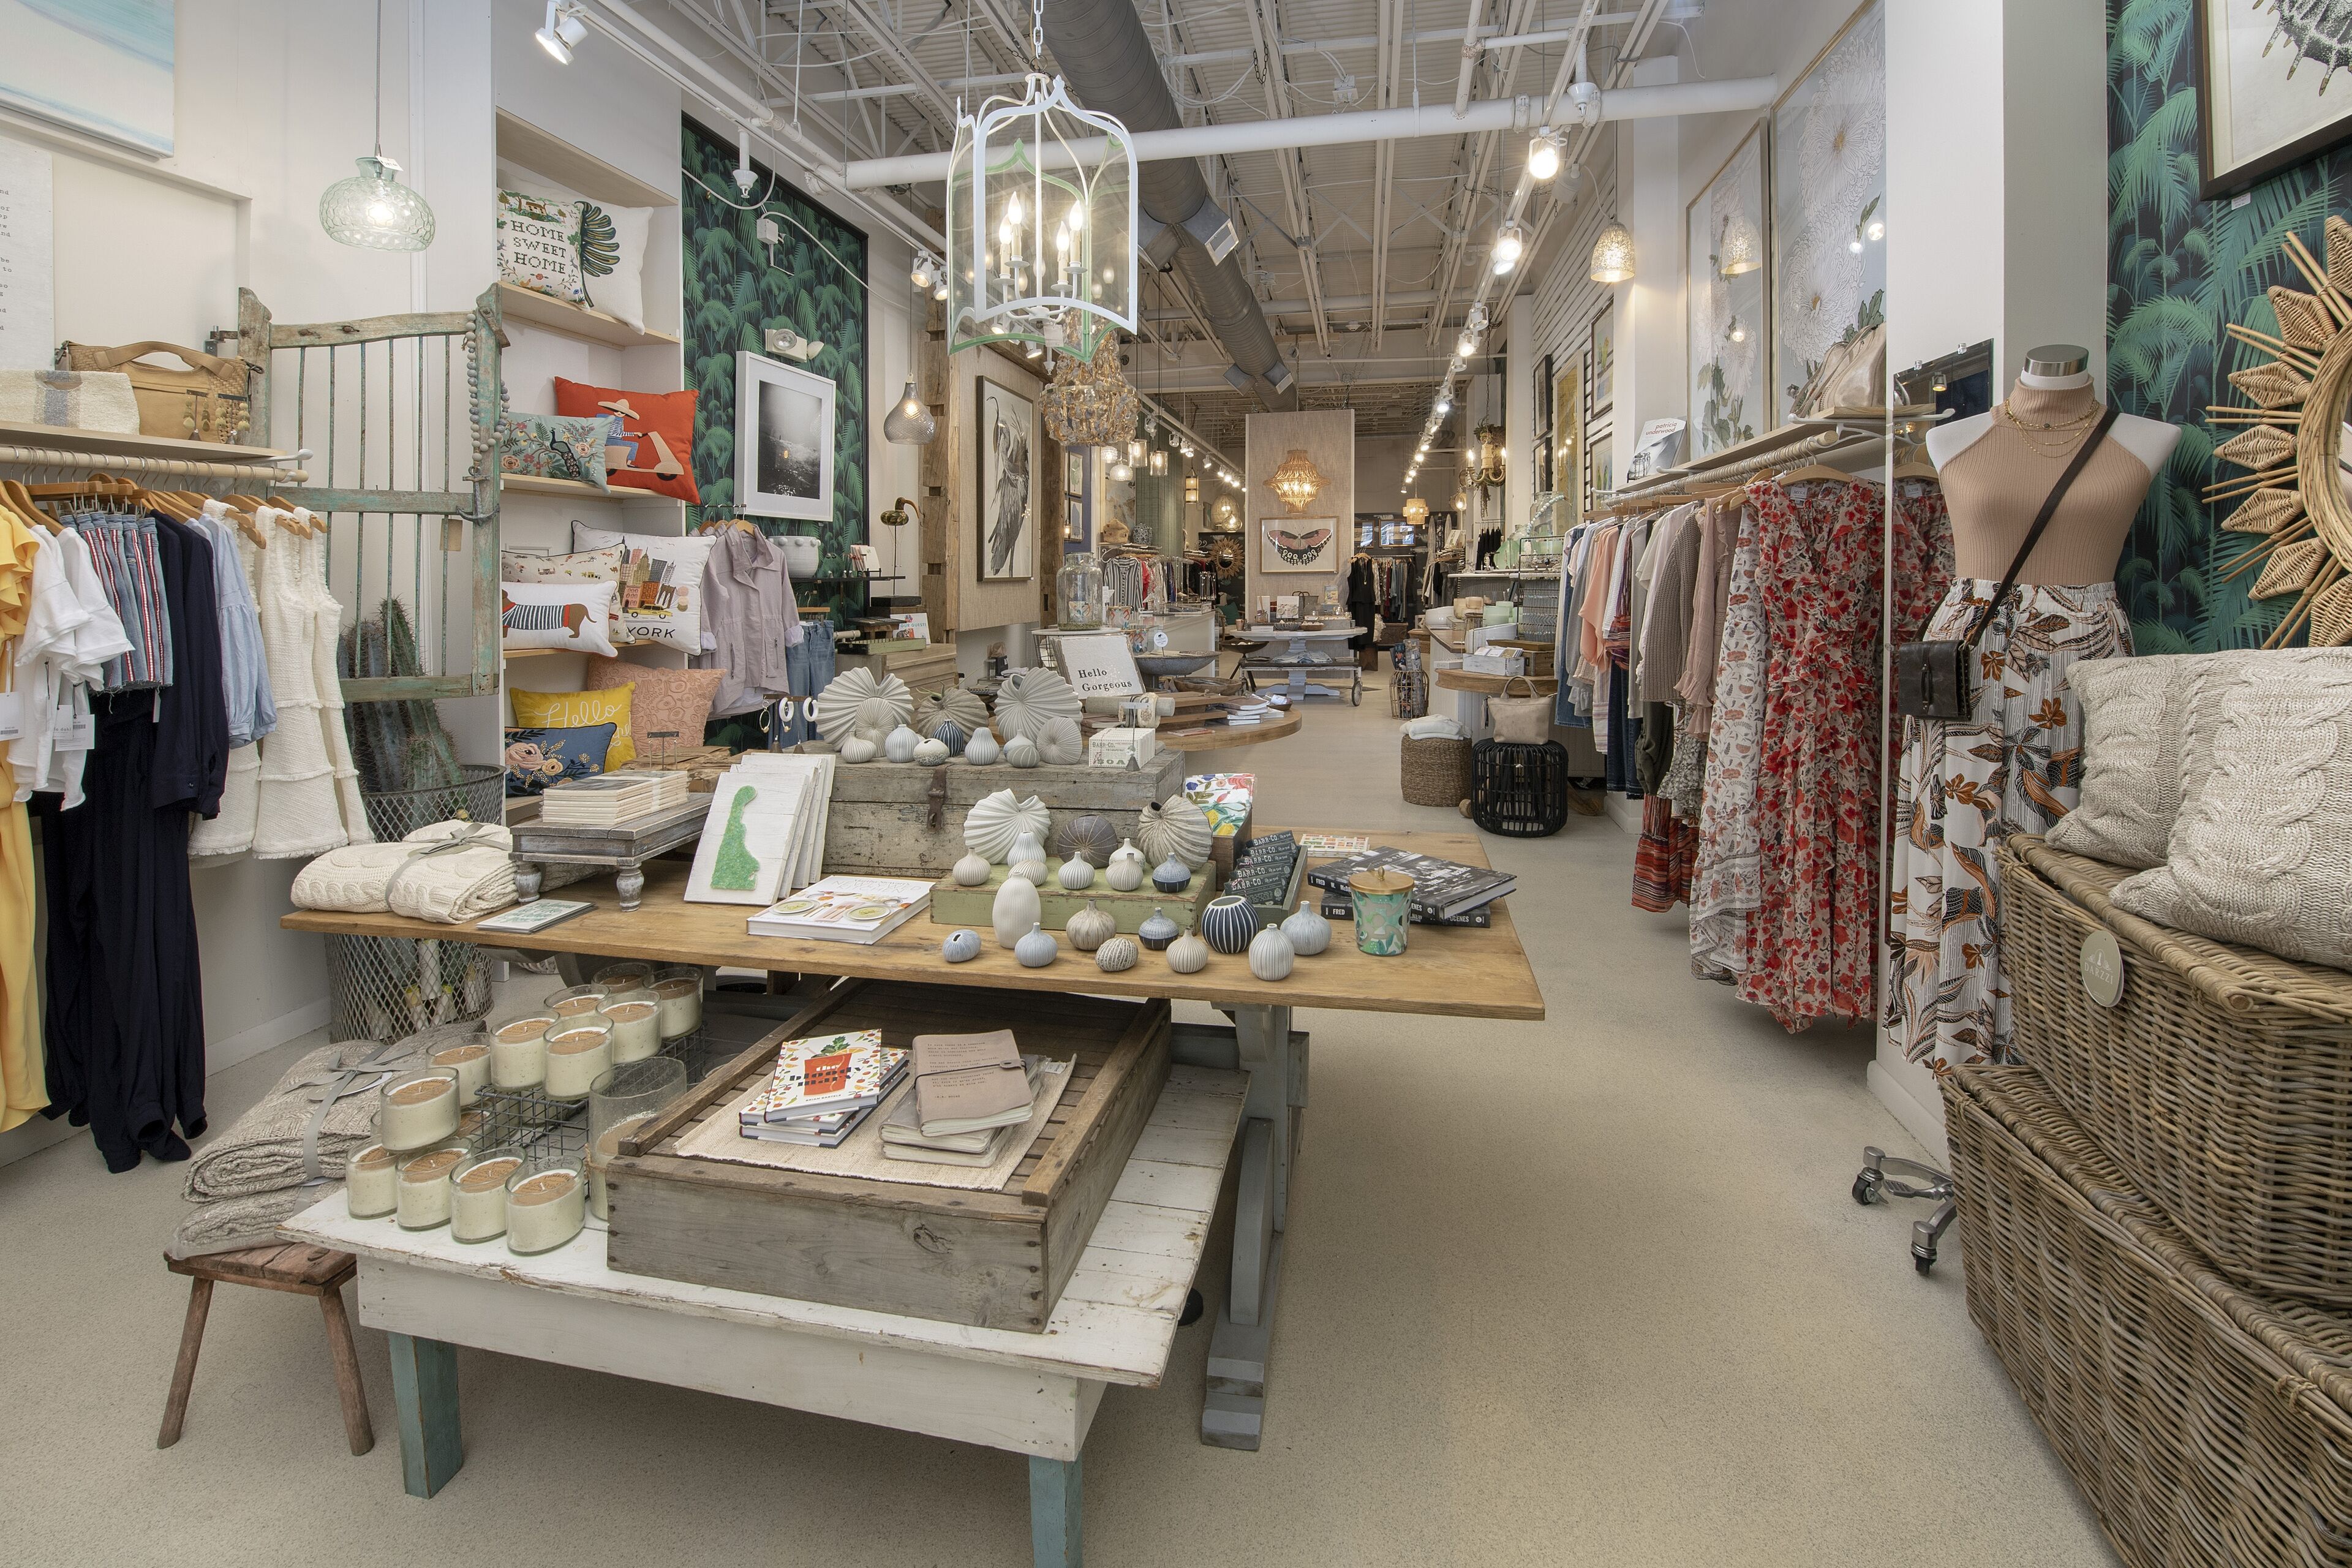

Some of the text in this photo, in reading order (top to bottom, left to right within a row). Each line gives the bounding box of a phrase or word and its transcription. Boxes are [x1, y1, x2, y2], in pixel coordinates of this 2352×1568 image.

[510, 220, 565, 243] HOME
[513, 236, 566, 258] SWEET
[513, 251, 566, 274] HOME
[1646, 427, 1676, 435] underwood
[1654, 421, 1677, 432] patricia
[627, 627, 676, 638] YORK
[1077, 668, 1107, 679] Hello
[1082, 681, 1132, 692] Gorgeous
[534, 700, 622, 728] Hello
[1411, 903, 1422, 911] ENES
[2084, 962, 2113, 985] DARZZI
